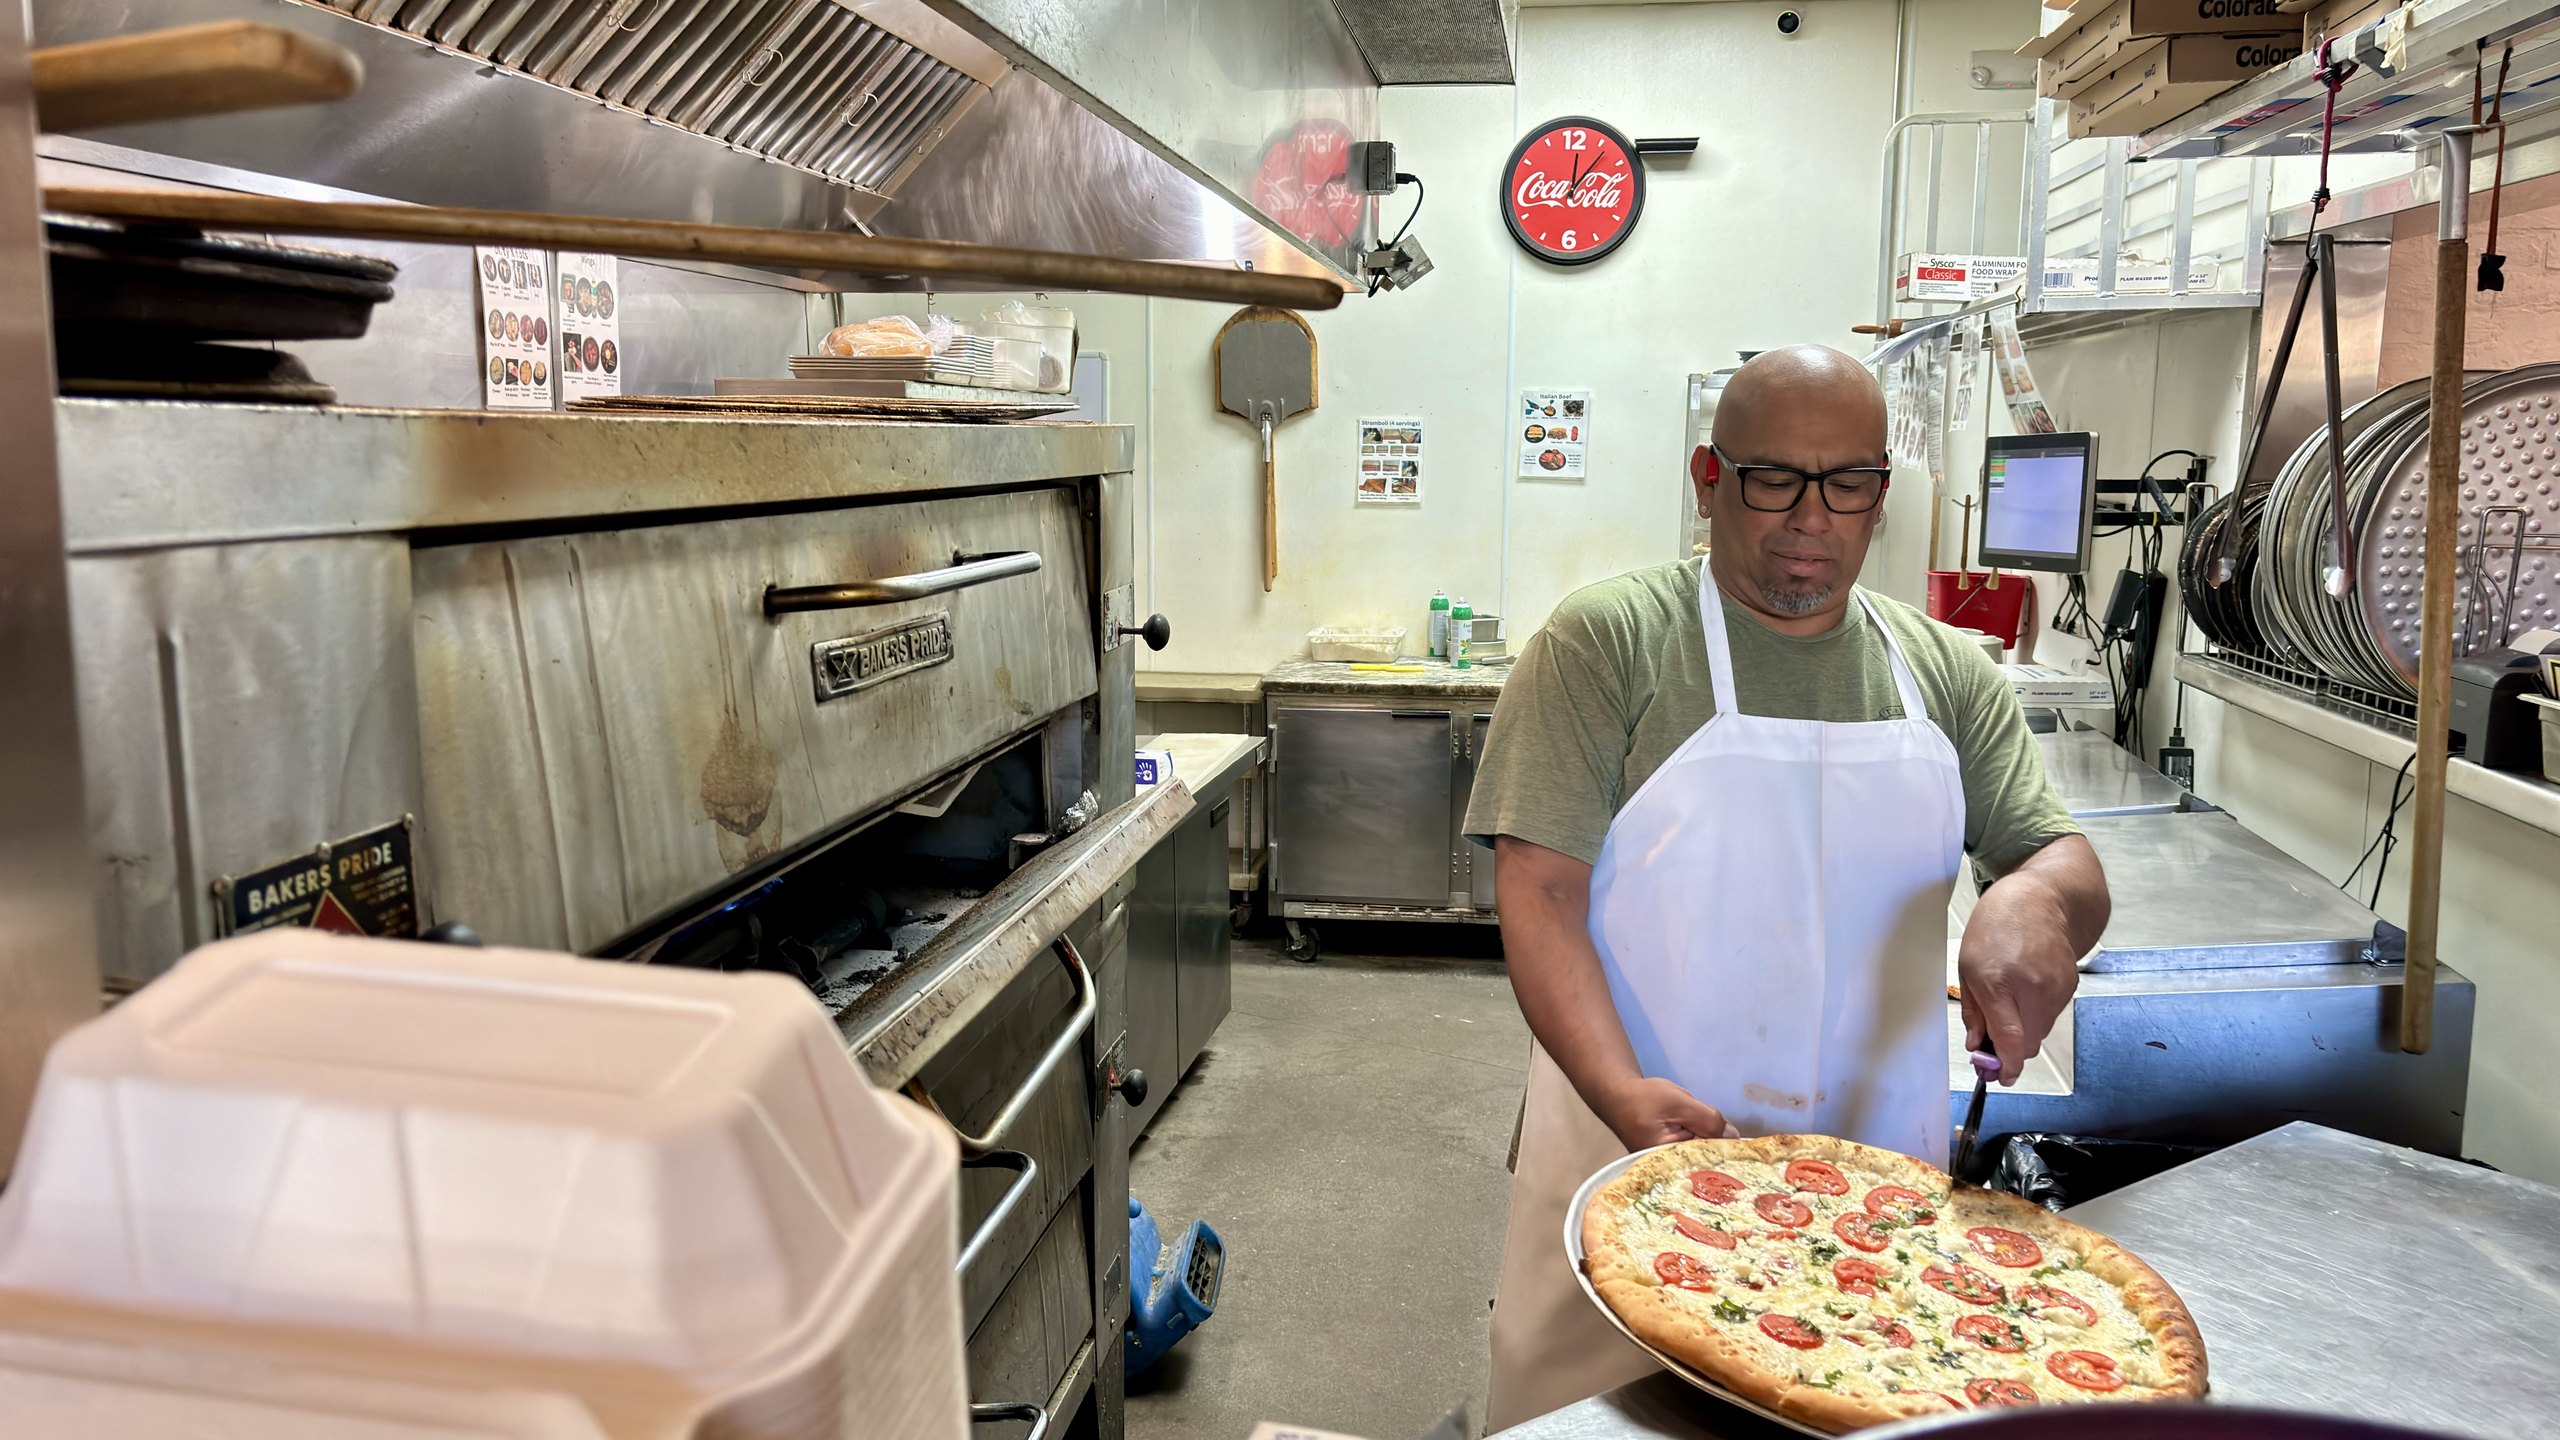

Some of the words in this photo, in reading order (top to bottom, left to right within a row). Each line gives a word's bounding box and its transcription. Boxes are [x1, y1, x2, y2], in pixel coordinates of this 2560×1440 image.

[1562, 130, 1587, 151] 12
[1561, 230, 1577, 249] 6
[1930, 258, 1956, 269] Sysco
[1972, 260, 2015, 268] ALUMINUM
[2016, 261, 2027, 269] FO
[1925, 268, 1958, 281] Classic
[859, 635, 908, 679] BAKERS
[910, 624, 947, 659] PRIDE
[248, 864, 332, 914] BAKERS
[338, 842, 393, 880] PRIDE
